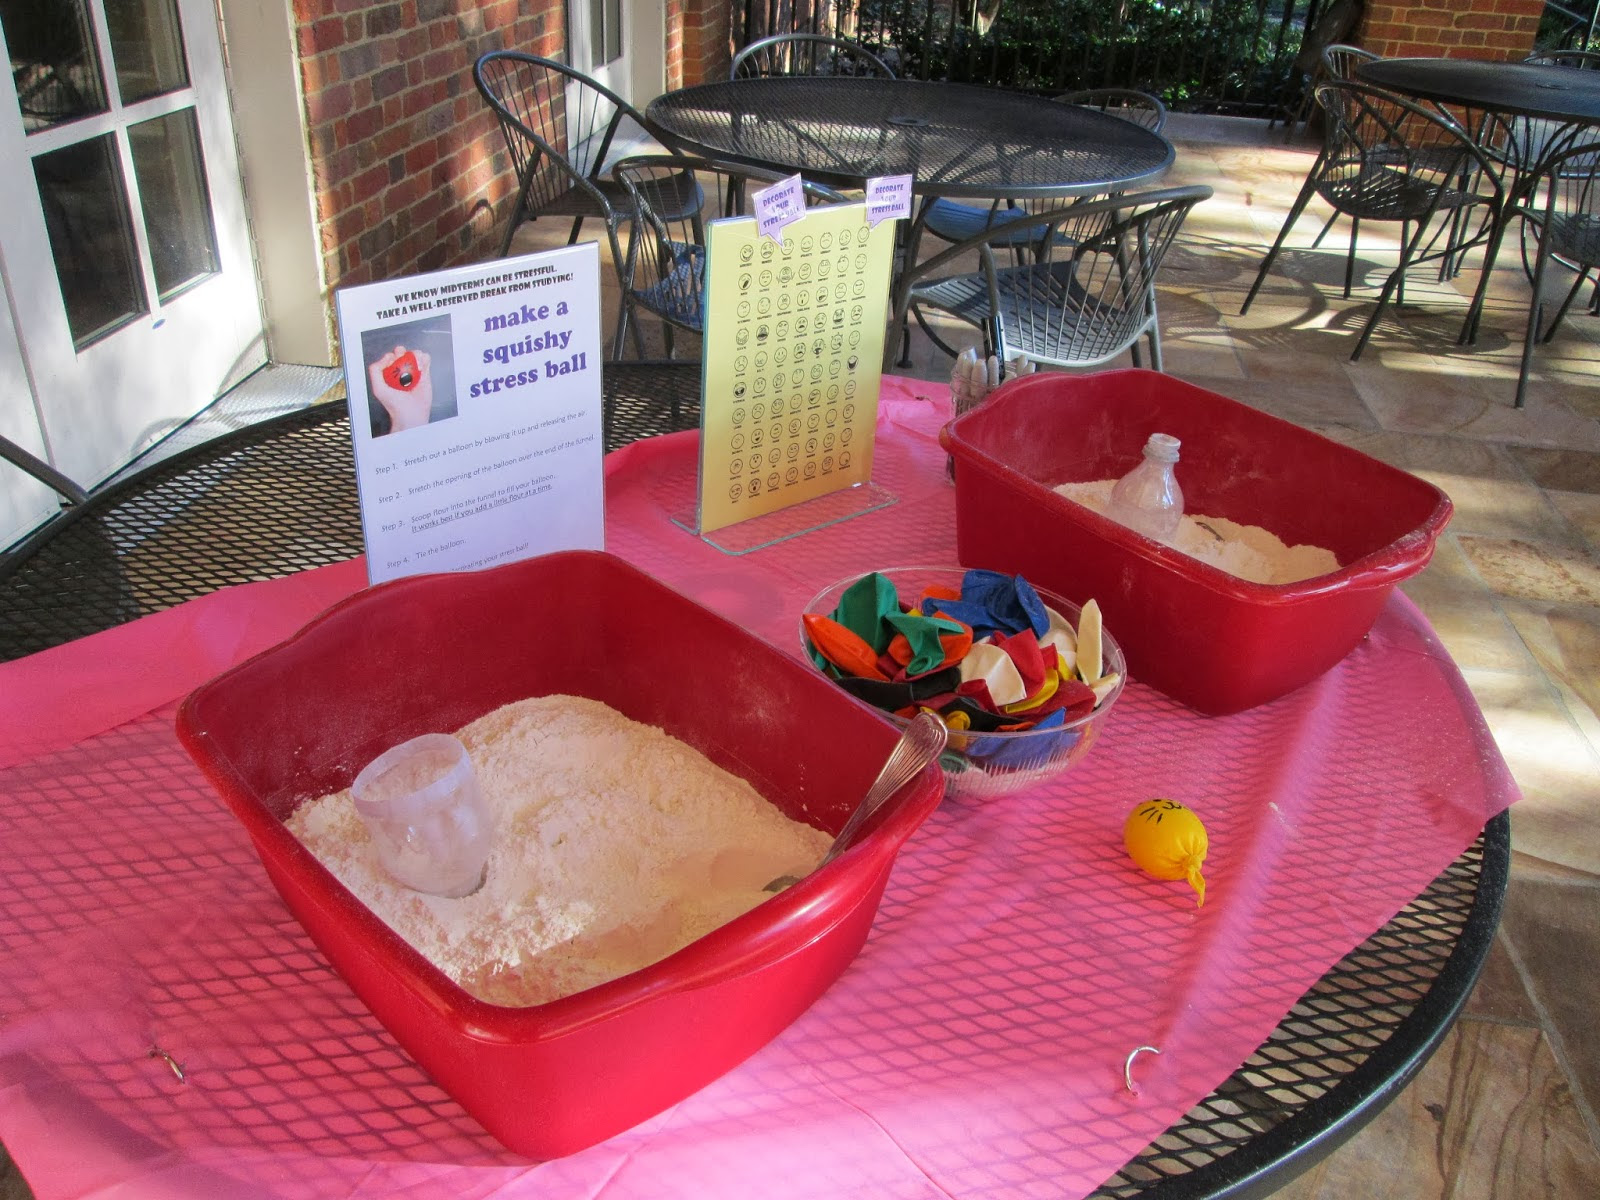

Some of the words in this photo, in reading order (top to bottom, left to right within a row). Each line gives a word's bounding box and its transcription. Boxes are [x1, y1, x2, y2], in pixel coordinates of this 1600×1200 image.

[763, 186, 795, 207] DECORATE
[875, 183, 904, 194] DECORATE
[376, 308, 400, 320] TAKE
[401, 306, 408, 316] A
[409, 291, 479, 314] WELL-DESERVED
[480, 285, 507, 299] BREAK
[508, 281, 531, 294] FROM
[532, 273, 574, 289] STUDYING!
[395, 294, 409, 304] WE
[411, 287, 439, 302] KNOW
[440, 278, 485, 296] MIDTERMS
[486, 274, 501, 287] CAN
[503, 273, 513, 283] BE
[514, 265, 557, 281] STRESSFUL.
[484, 304, 550, 332] make
[556, 301, 569, 316] a
[482, 329, 573, 364] squishy
[470, 368, 538, 398] stress
[545, 352, 587, 379] ball
[375, 466, 391, 476] Step
[392, 463, 398, 471] 1.
[404, 455, 428, 467] Stretch
[429, 452, 440, 460] out
[448, 443, 474, 454] balloon
[475, 439, 483, 447] by
[484, 432, 510, 444] blowing
[517, 428, 526, 436] up
[527, 424, 539, 432] and
[540, 416, 566, 428] releasing
[567, 412, 577, 420] the
[578, 410, 587, 418] air.
[378, 494, 394, 504] Step
[395, 491, 402, 500] 2.
[408, 484, 431, 495] Stretch
[433, 480, 444, 488] the
[445, 471, 472, 484] opening
[473, 467, 480, 476] of
[482, 464, 492, 473] the
[493, 458, 517, 470] balloon
[518, 454, 532, 462] over
[533, 449, 543, 457] the
[545, 446, 556, 454] end
[558, 442, 564, 450] of
[565, 440, 575, 448] the
[381, 523, 396, 533] Step
[399, 520, 405, 528] 3.
[411, 512, 431, 523] Scoop
[433, 507, 449, 516] flour
[450, 503, 464, 511] into
[465, 499, 476, 507] the
[477, 491, 496, 502] funnel
[506, 485, 514, 493] fill
[515, 482, 530, 492] your
[531, 474, 556, 486] balloon.
[411, 525, 417, 533] It
[419, 520, 439, 530] works
[440, 514, 453, 523] best
[460, 508, 474, 518] you
[475, 503, 487, 512] add
[493, 497, 508, 506] little
[508, 493, 524, 502] flour
[525, 489, 531, 497] at
[386, 560, 402, 569] Step
[428, 547, 438, 555] the
[440, 539, 466, 551] balloon.
[484, 554, 498, 565] your
[500, 549, 515, 558] stress
